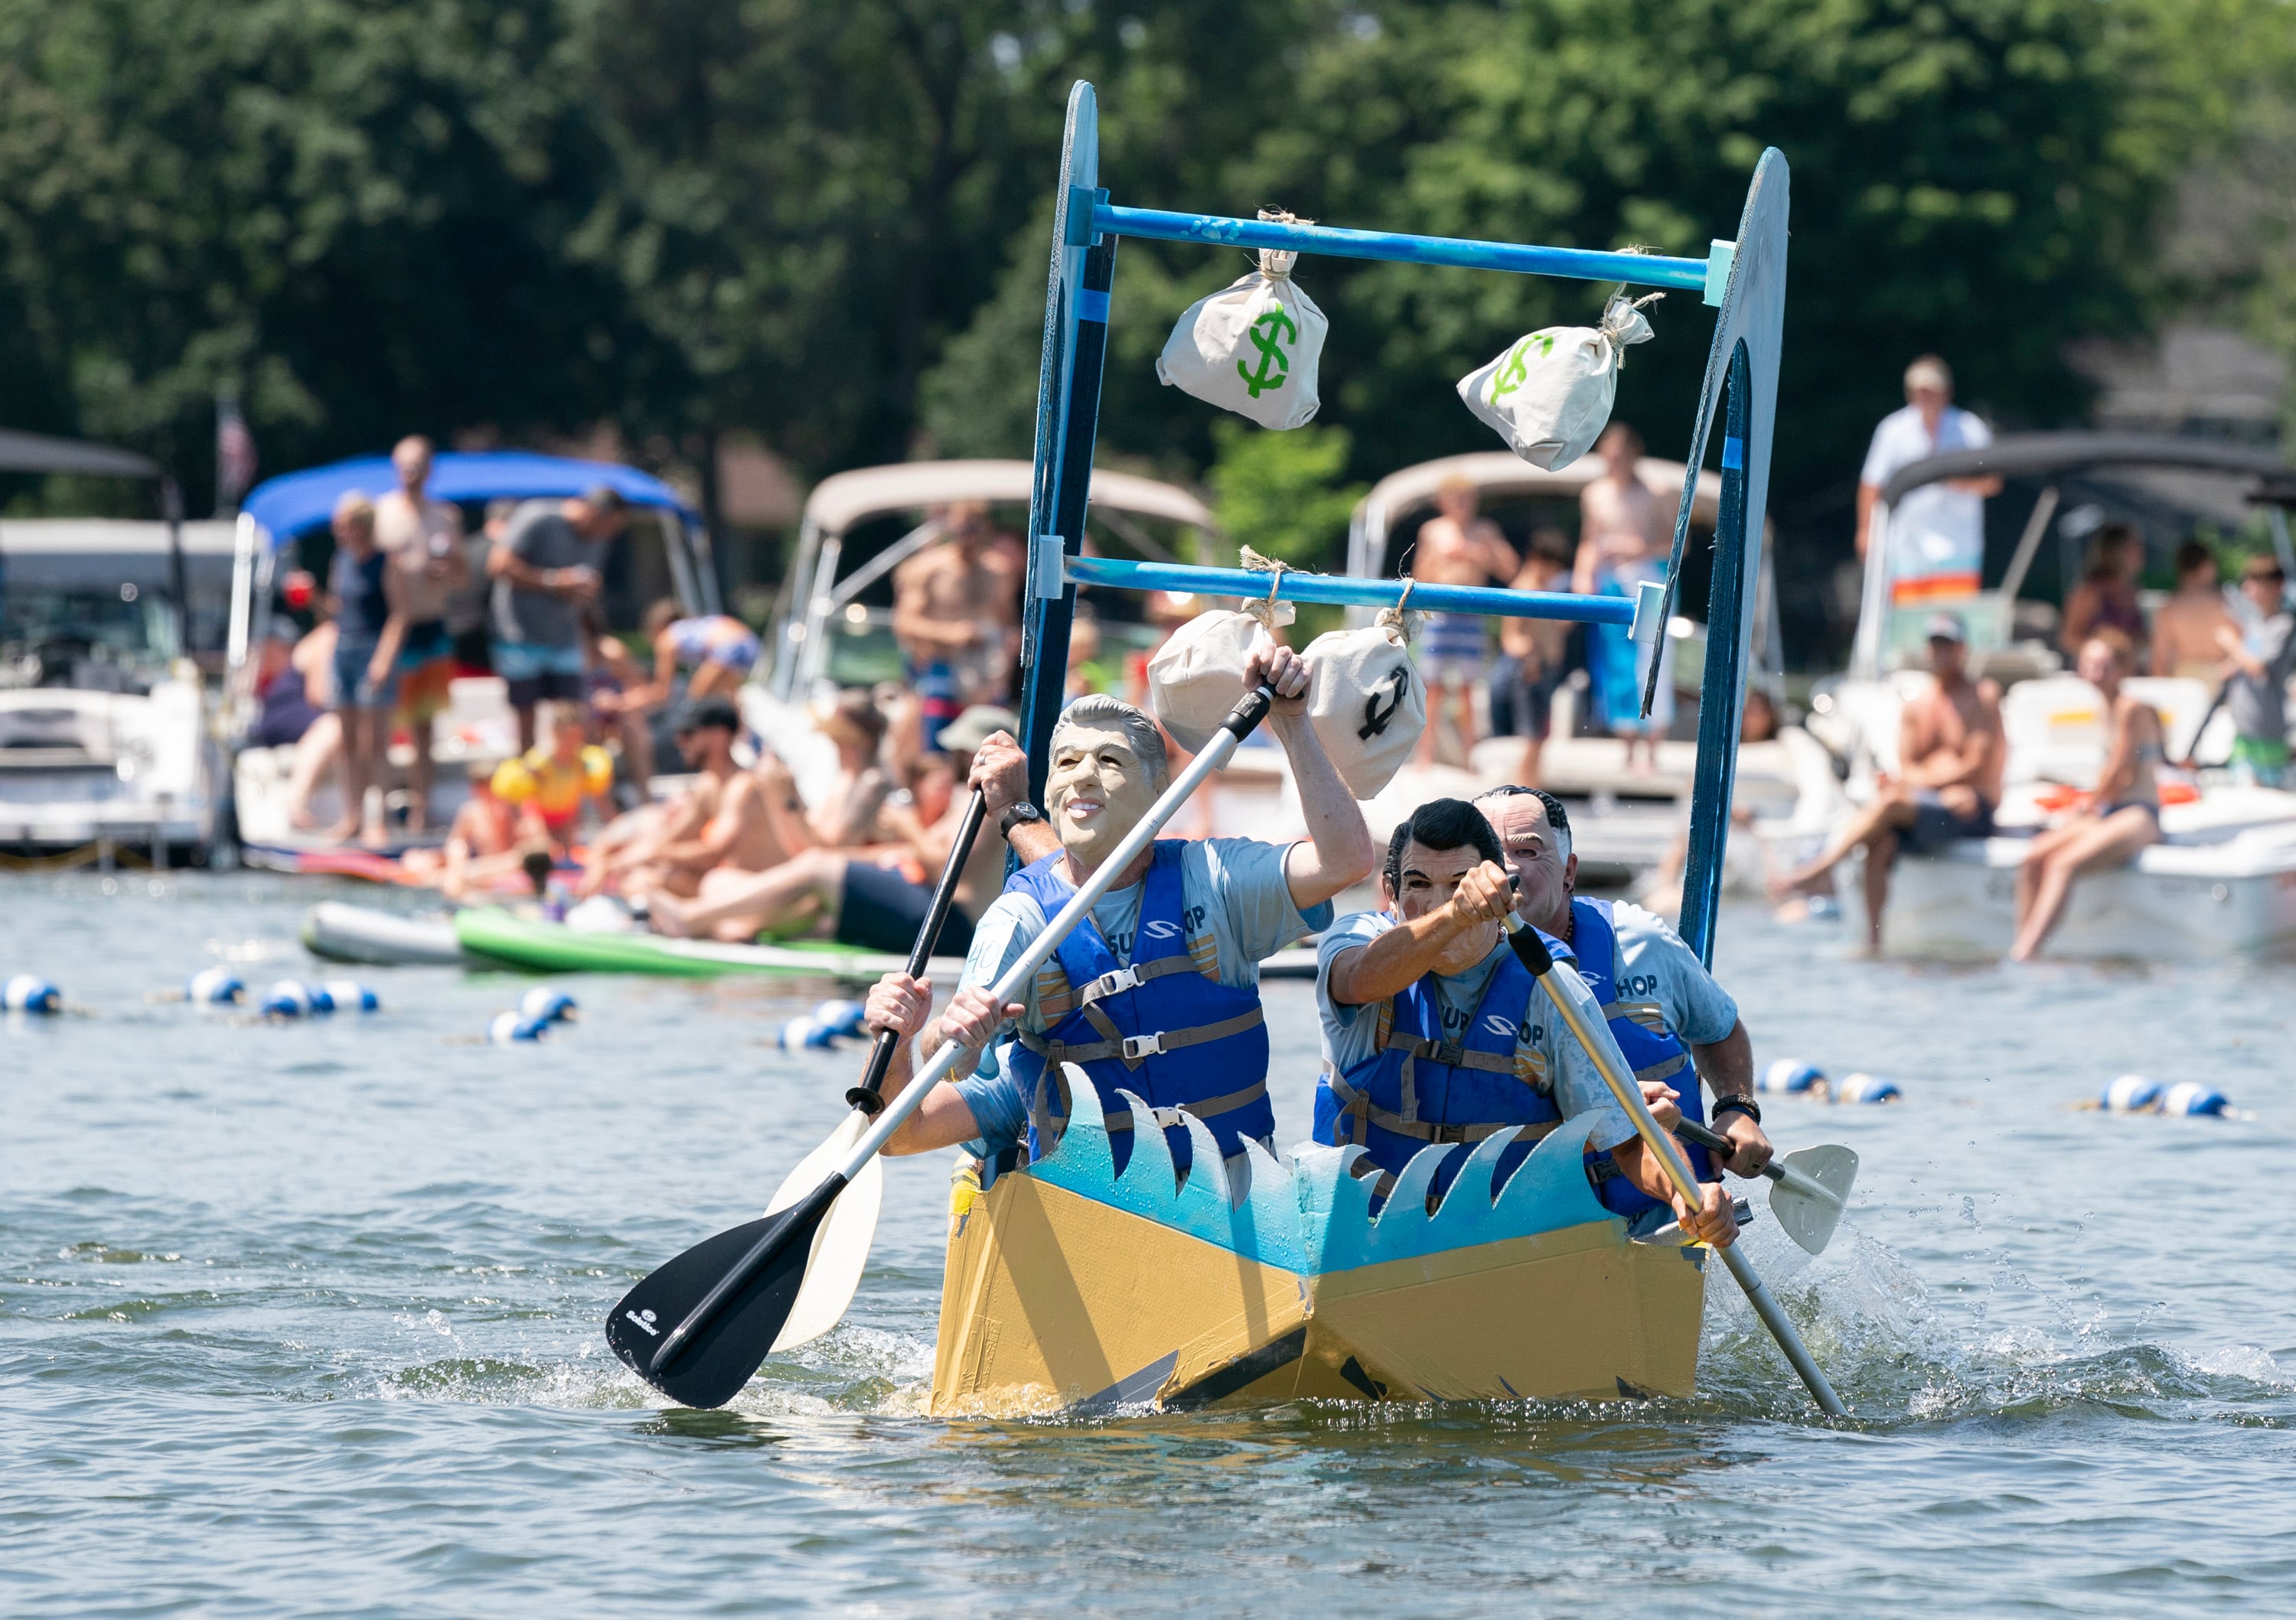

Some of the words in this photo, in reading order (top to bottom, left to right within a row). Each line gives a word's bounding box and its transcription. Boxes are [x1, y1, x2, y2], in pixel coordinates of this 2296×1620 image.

[1237, 302, 1296, 399] $
[1490, 334, 1554, 407] $
[967, 940, 1002, 974] 40
[625, 1310, 657, 1336] Solstice
